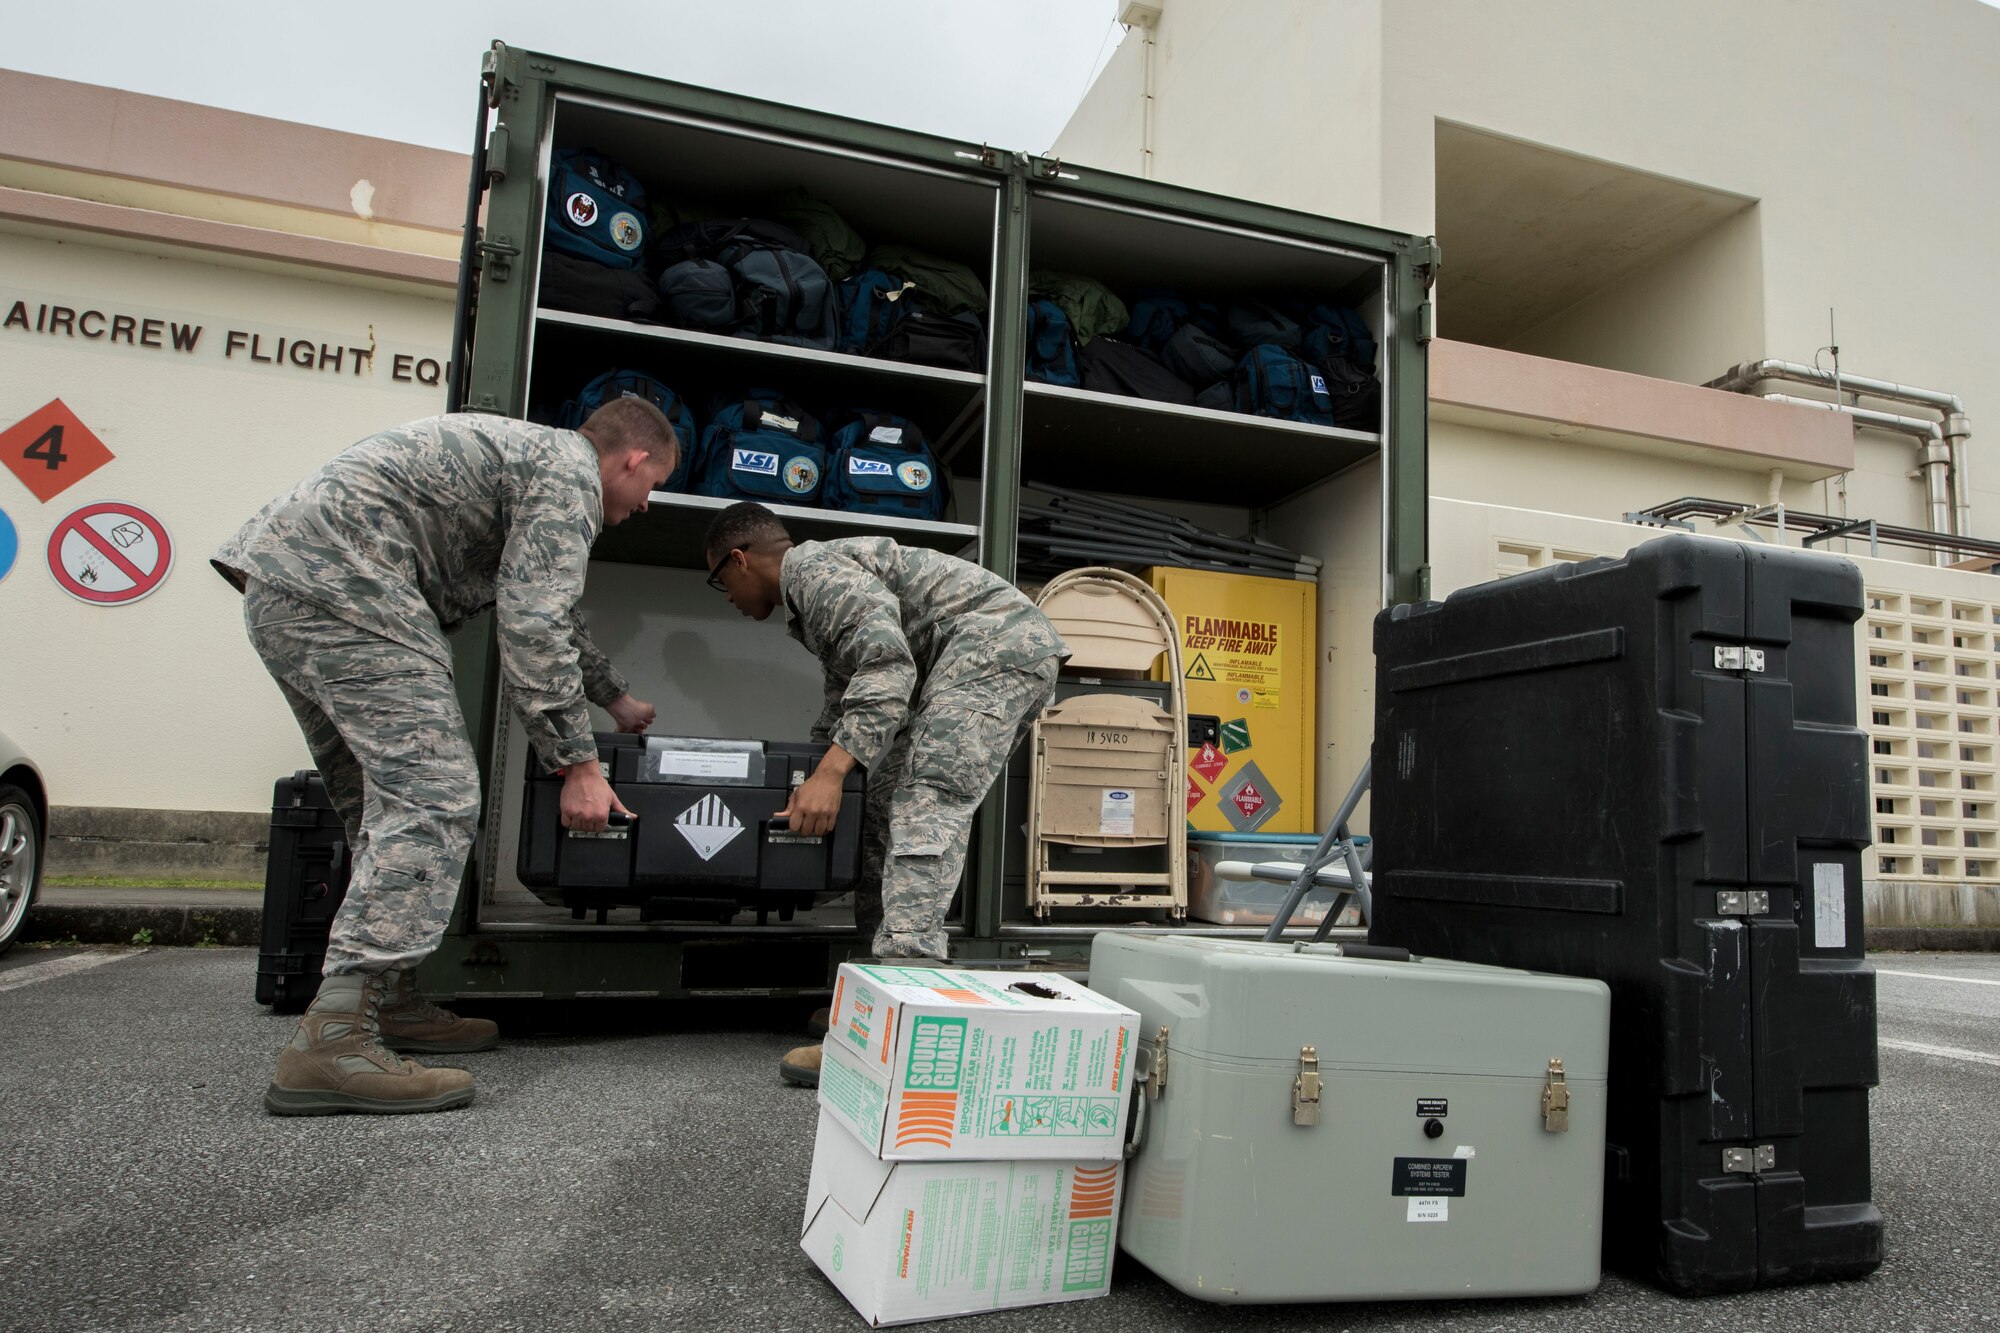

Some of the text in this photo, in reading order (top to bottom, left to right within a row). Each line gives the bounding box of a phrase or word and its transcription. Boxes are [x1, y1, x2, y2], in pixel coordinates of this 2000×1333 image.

[3, 300, 203, 352] AIRCREW
[225, 330, 370, 376] FLIGHT
[23, 424, 68, 471] 4
[1185, 635, 1277, 656] KEEP FIRE AWAY
[1186, 615, 1277, 642] FLAMMABLE
[1226, 672, 1265, 680] INFLAMMABLE
[1229, 659, 1263, 667] INFLAMABLE
[1087, 731, 1095, 743] 18
[1236, 795, 1262, 804] FLAMMABLE
[705, 845, 711, 853] 9
[909, 1023, 940, 1086] SOUND
[933, 1024, 963, 1086] GUARD
[1114, 1026, 1125, 1069] DYNAMICS
[960, 1080, 973, 1134] DISPOSABLE
[971, 1028, 980, 1056] PLUGS
[1050, 1169, 1063, 1232] DISPOSABLE
[901, 1233, 912, 1278] DYNAMICS
[1043, 1259, 1052, 1291] PLUGS
[1067, 1225, 1090, 1283] GUARD
[1085, 1223, 1108, 1283] SOUND
